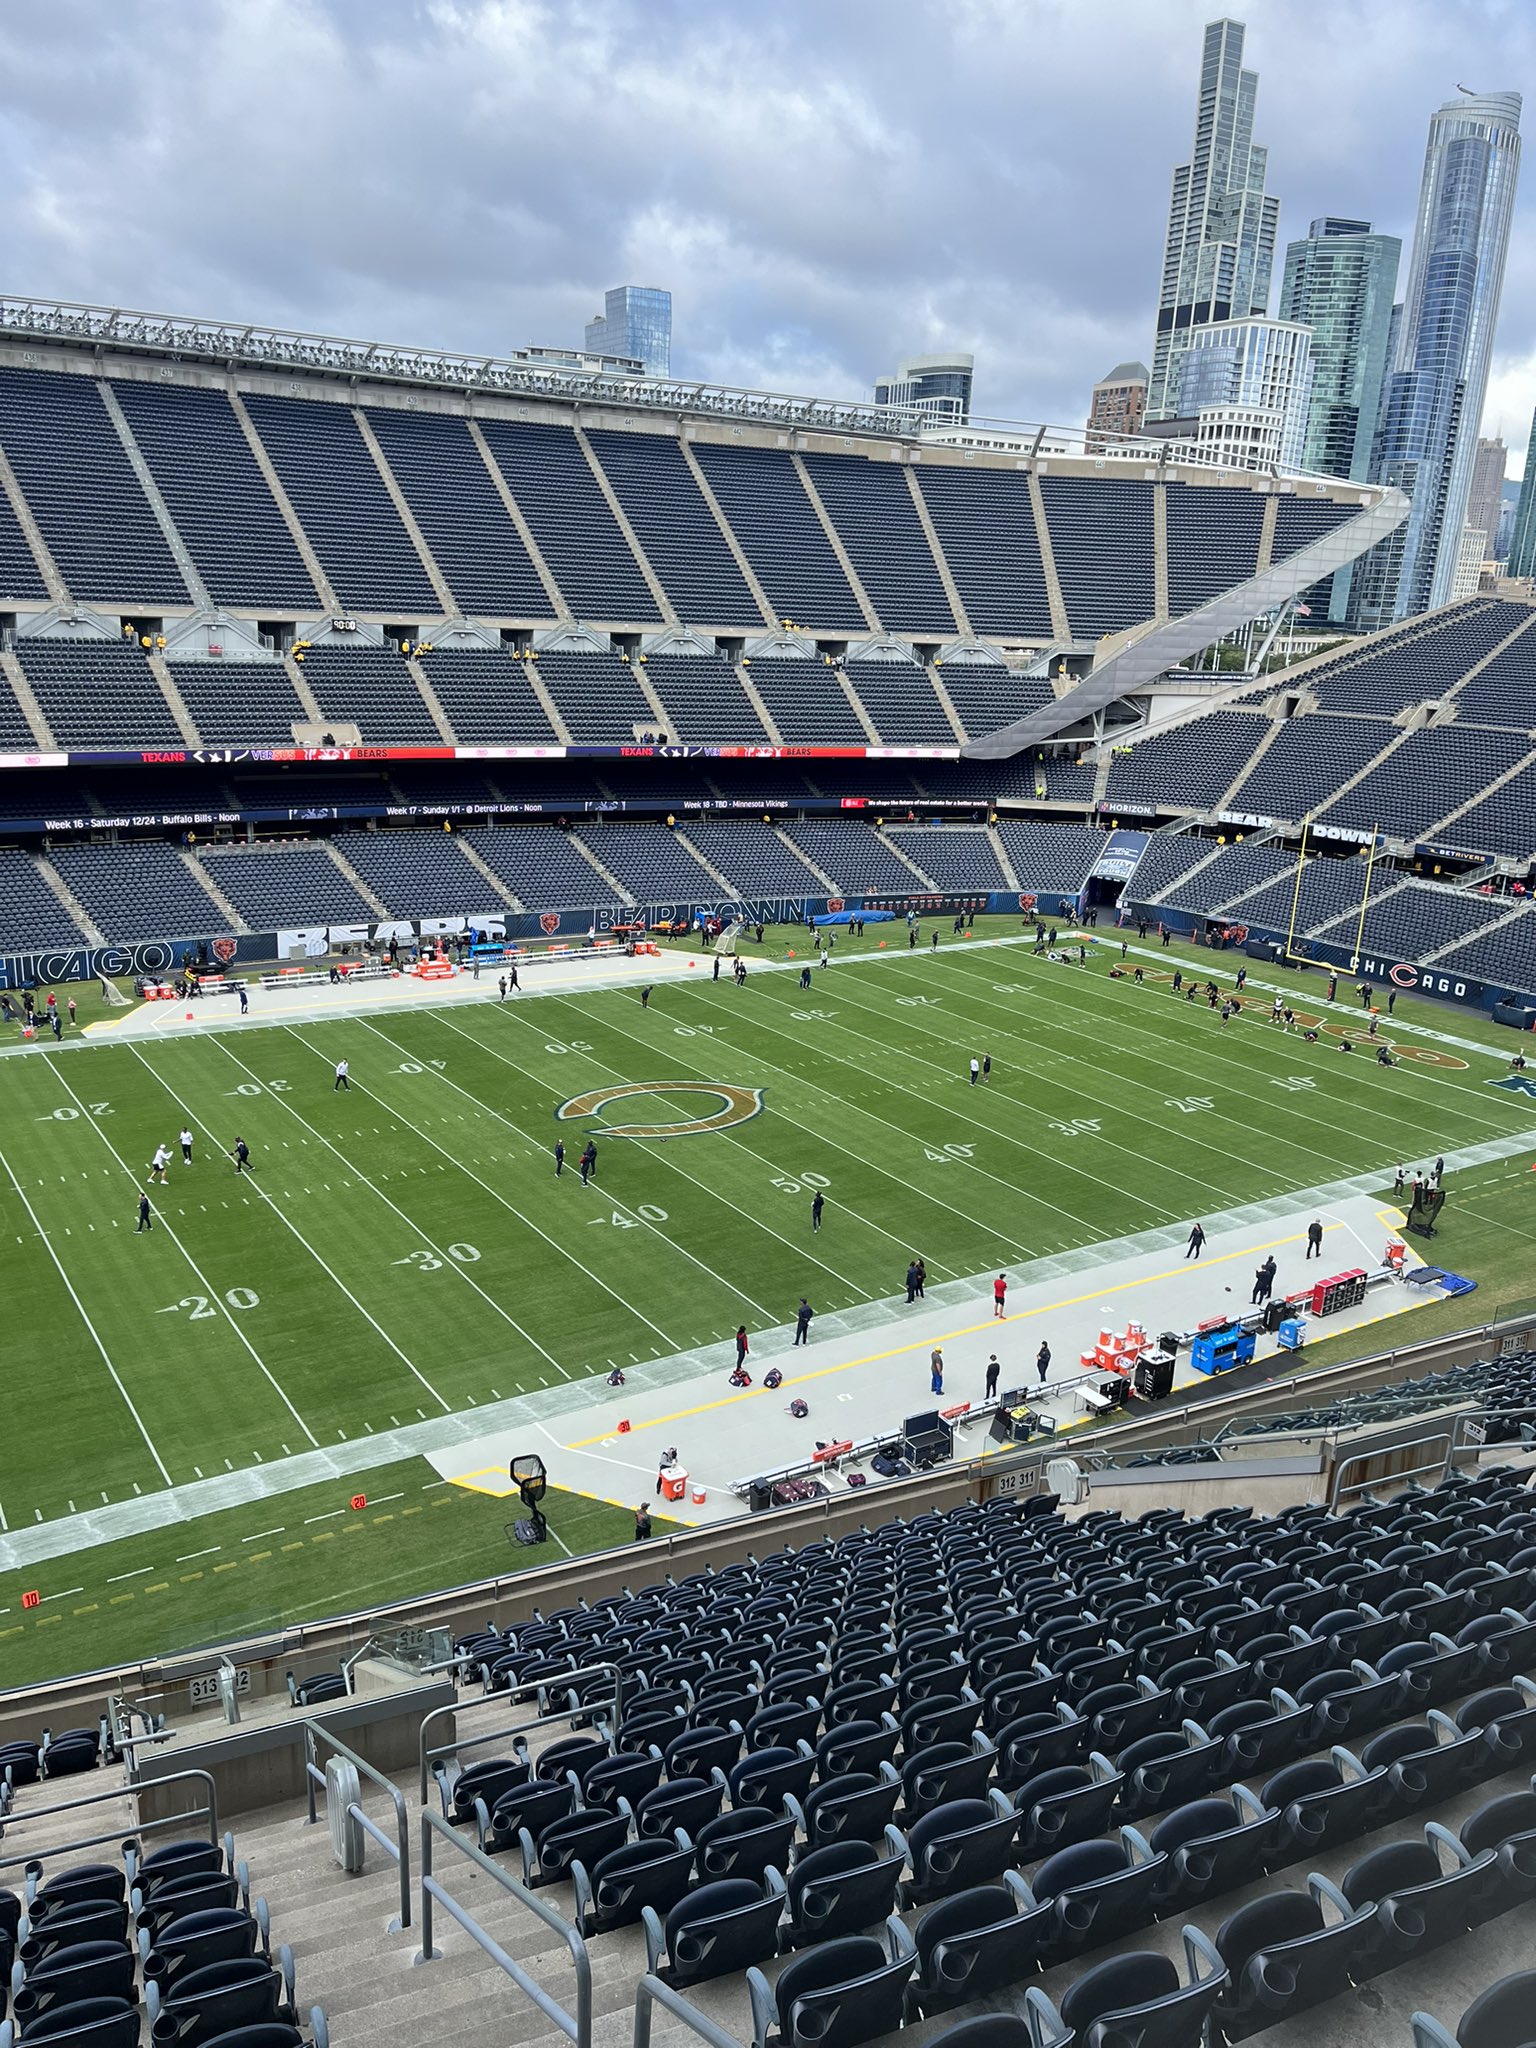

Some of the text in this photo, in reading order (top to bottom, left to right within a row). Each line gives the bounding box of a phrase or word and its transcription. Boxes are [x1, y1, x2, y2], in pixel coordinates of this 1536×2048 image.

[141, 749, 388, 763] TEXANS VERSUS BEARS
[620, 747, 653, 756] TEXANS
[787, 748, 811, 756] BEARS
[386, 806, 407, 815] Week
[409, 806, 416, 814] 17
[423, 806, 449, 815] Sunday
[451, 805, 460, 814] 1/1
[466, 806, 473, 814] @
[474, 804, 498, 813] Detroit
[500, 804, 518, 812] Lions
[524, 804, 543, 812] Noon
[715, 800, 728, 808] TBD
[732, 800, 764, 808] Minnesota
[765, 800, 788, 808] Vikings
[45, 820, 71, 830] Week
[73, 819, 84, 828] 16
[91, 817, 130, 828] Saturday
[132, 816, 155, 825] 12/24
[163, 814, 193, 824] Buffalo
[194, 813, 212, 823] Bills
[219, 813, 240, 822] Noon
[1218, 812, 1375, 845] BEAR DOWN
[1439, 850, 1486, 862] BETRIVERS
[595, 904, 677, 930] BEAR
[1350, 956, 1466, 997] CHICAGO
[896, 995, 937, 1007] 20
[790, 1009, 833, 1021] 30
[673, 1024, 717, 1037] 40
[544, 1040, 595, 1055] 50
[399, 1058, 448, 1074] 40
[236, 1079, 293, 1097] 30
[1269, 1075, 1318, 1091] 10
[52, 1102, 116, 1121] 20
[1164, 1096, 1216, 1113] 20
[1048, 1118, 1102, 1136] 30
[923, 1143, 976, 1163] 40
[770, 1172, 832, 1194] 50
[611, 1204, 670, 1230] 40
[409, 1242, 482, 1272] 30
[179, 1287, 260, 1320] 20
[1503, 1339, 1514, 1350] 311
[620, 1420, 630, 1433] 30
[673, 1481, 683, 1492] G
[1000, 1471, 1035, 1490] 312 311
[354, 1496, 366, 1509] 20
[25, 1593, 37, 1606] 10
[193, 1670, 248, 1696] 313 12
